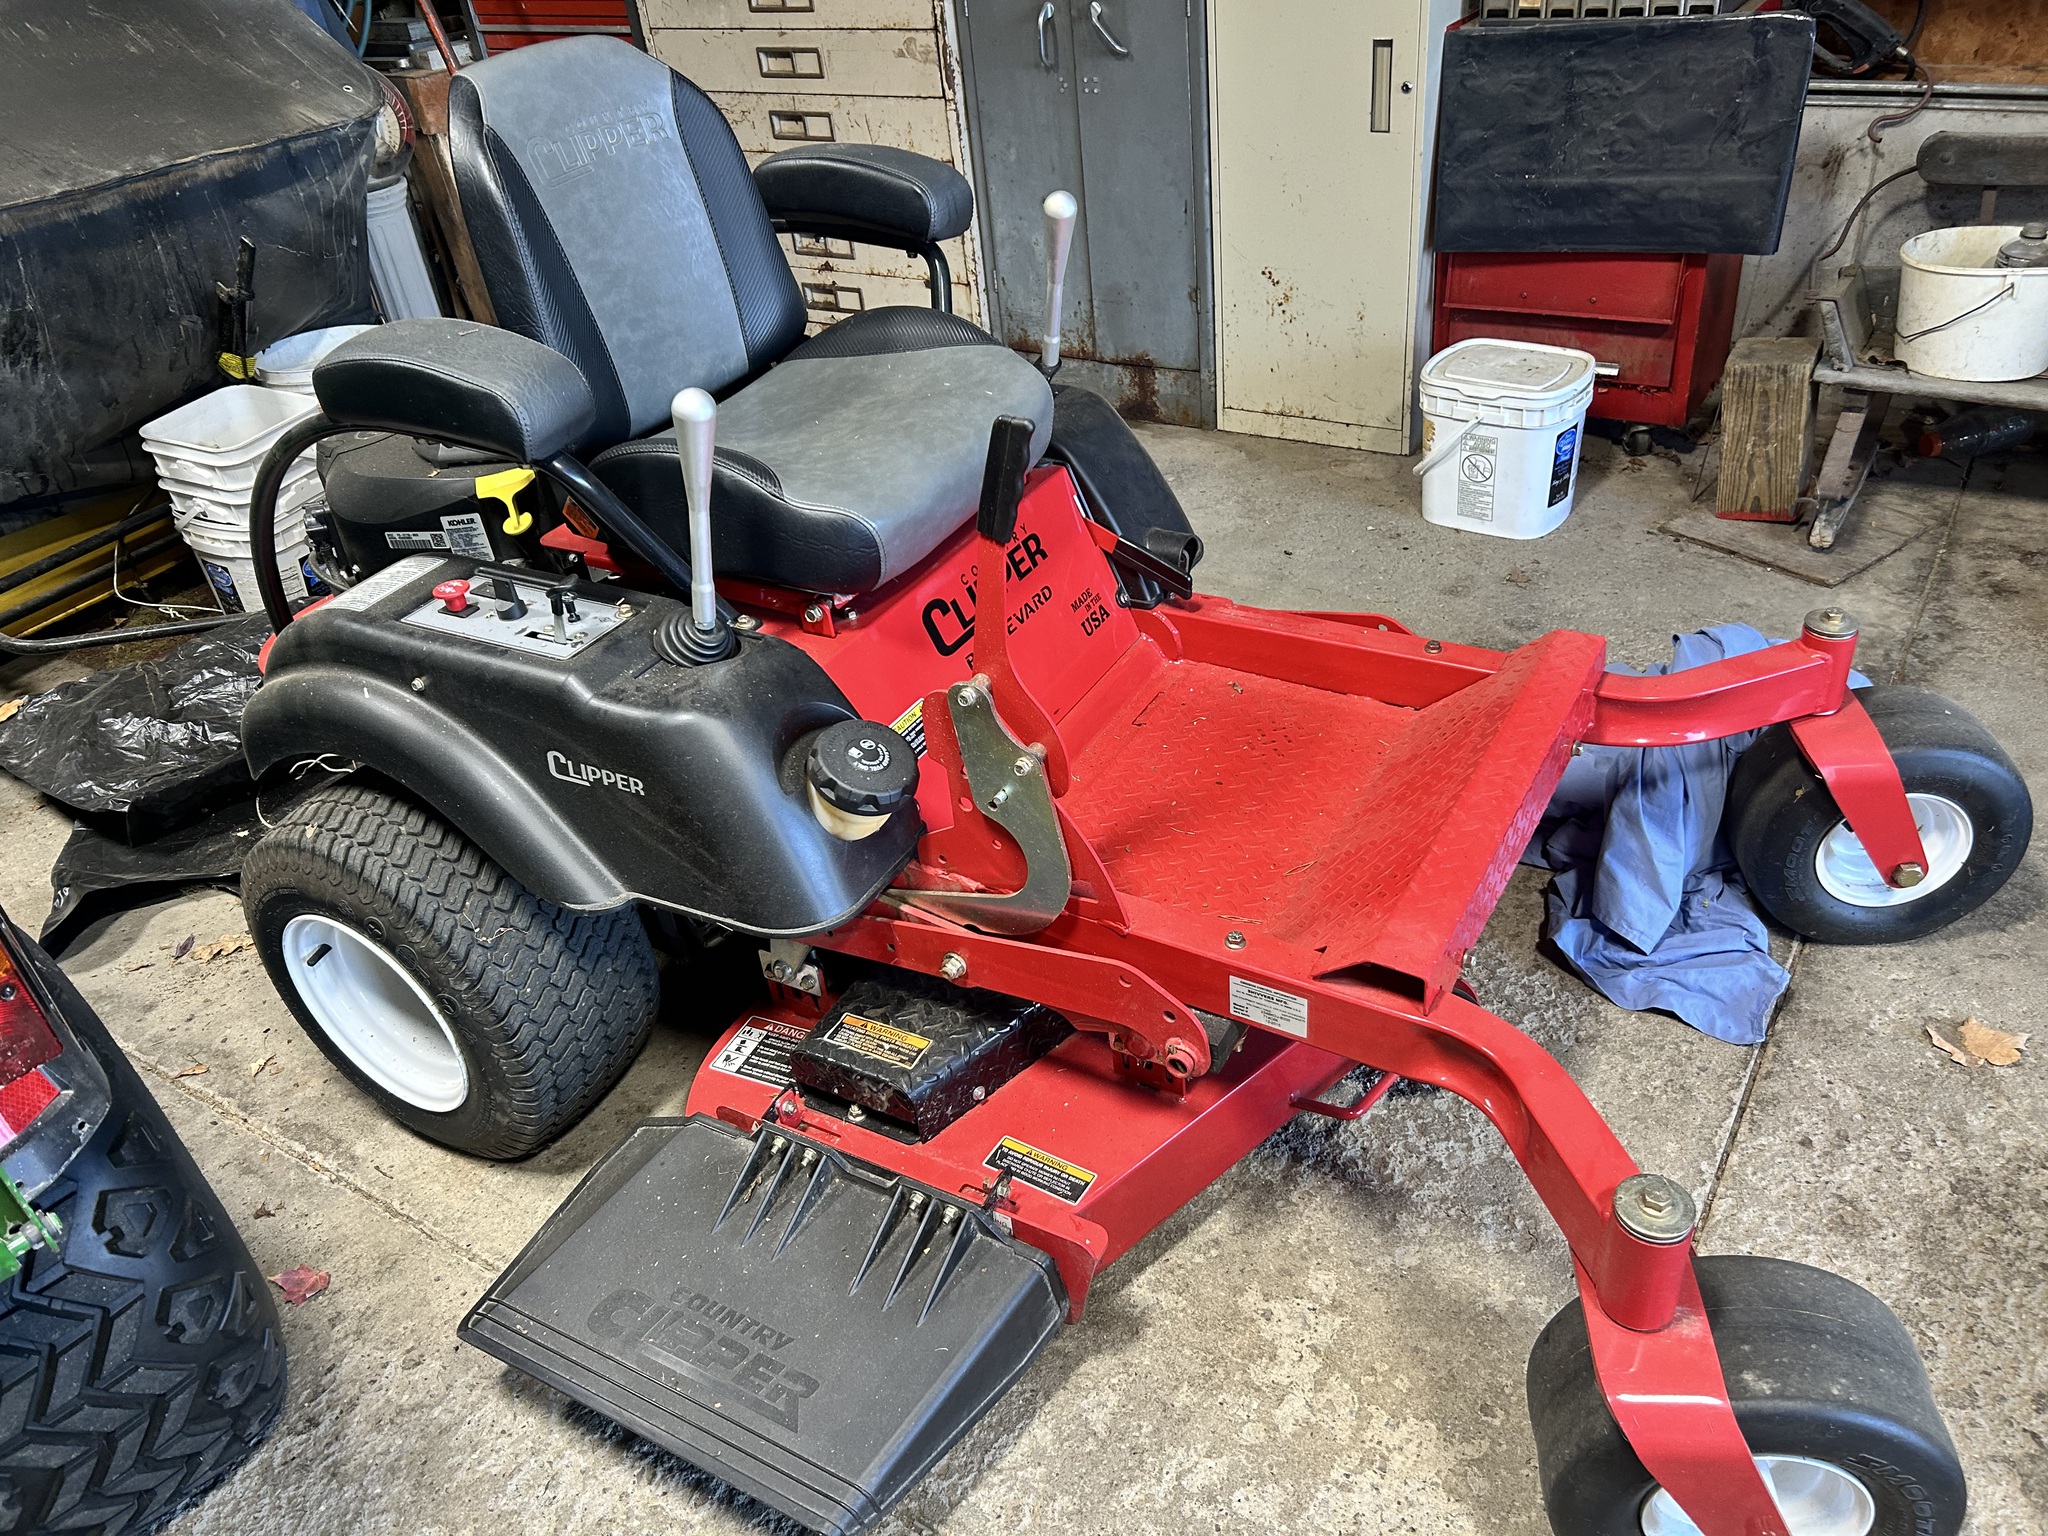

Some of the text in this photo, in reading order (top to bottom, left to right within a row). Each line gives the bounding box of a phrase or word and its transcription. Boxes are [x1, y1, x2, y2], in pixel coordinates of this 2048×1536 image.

[526, 112, 671, 189] CLIPPER
[447, 518, 477, 527] KOHLER
[1070, 587, 1093, 613] MADE
[1084, 592, 1102, 613] IN THE
[1080, 603, 1111, 637] USA
[546, 750, 645, 796] CLIPPER
[870, 1024, 908, 1042] WARNING
[1007, 1149, 1023, 1158] AVOID
[1021, 1155, 1043, 1167] SERIOUS
[1042, 1164, 1061, 1175] INJURY
[1067, 1176, 1085, 1186] DEATH
[1034, 1152, 1068, 1171] WARNING
[669, 1286, 796, 1351] COUNTRY
[587, 1289, 821, 1434] CLIPPER
